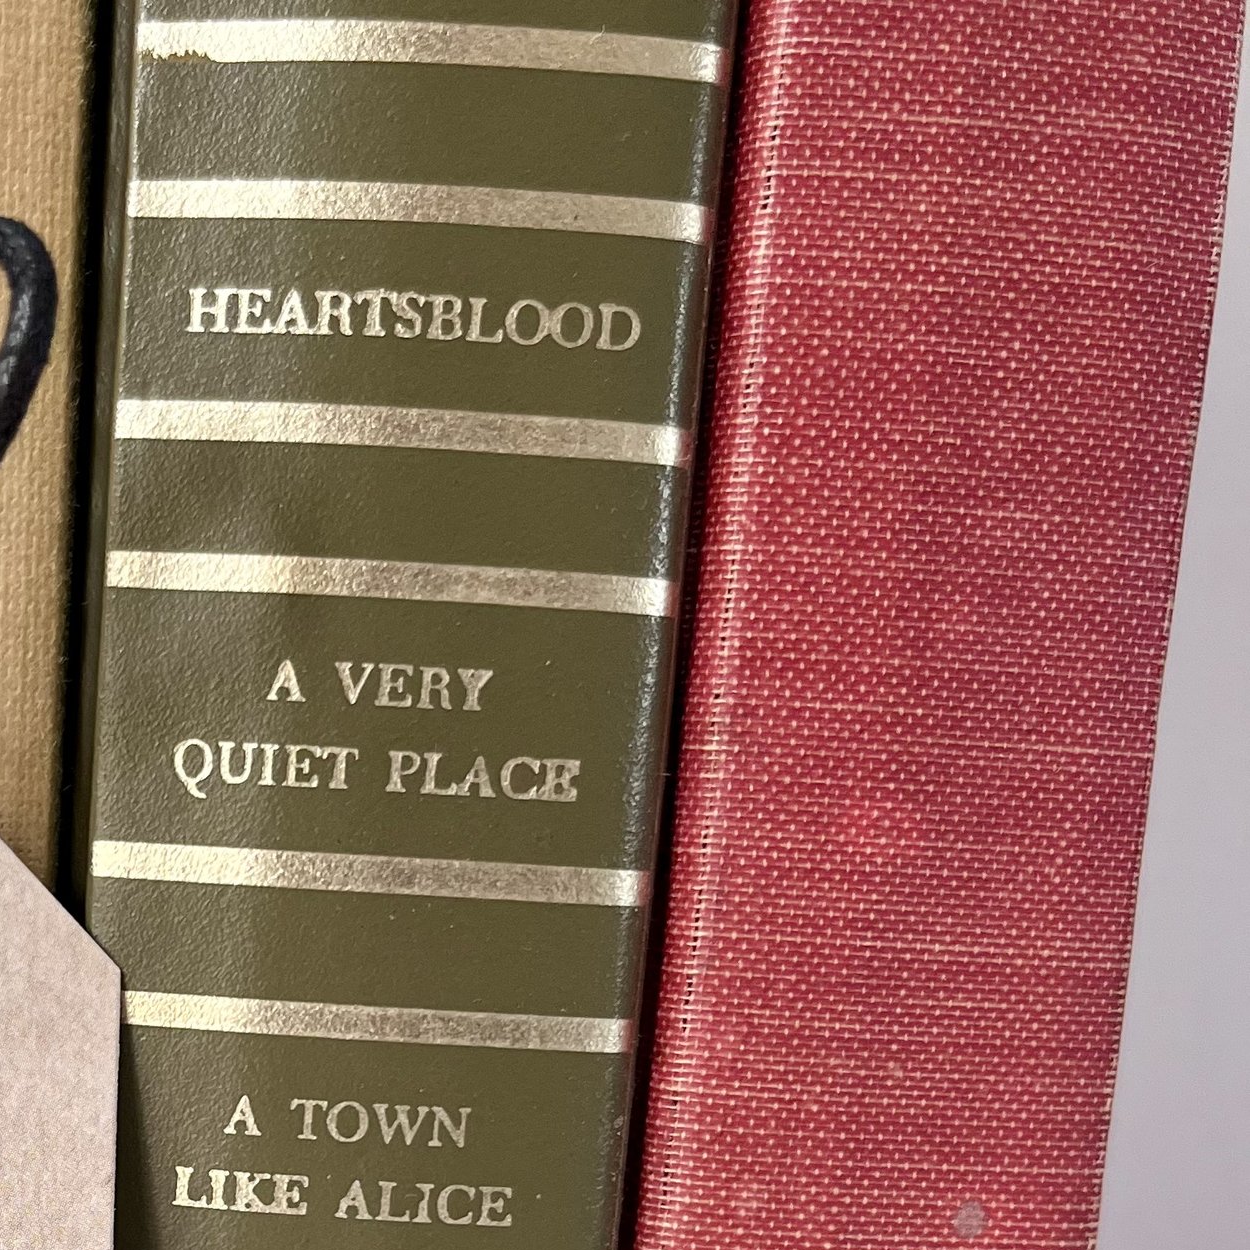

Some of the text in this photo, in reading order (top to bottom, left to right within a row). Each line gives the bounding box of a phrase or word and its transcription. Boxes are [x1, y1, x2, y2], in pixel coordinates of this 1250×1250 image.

[185, 286, 641, 351] HEARTSBLOOD
[266, 660, 493, 711] A VERY
[173, 739, 581, 802] QUIET PLACE
[223, 1095, 471, 1149] A TOWN
[172, 1165, 514, 1227] LIKE ALICE
